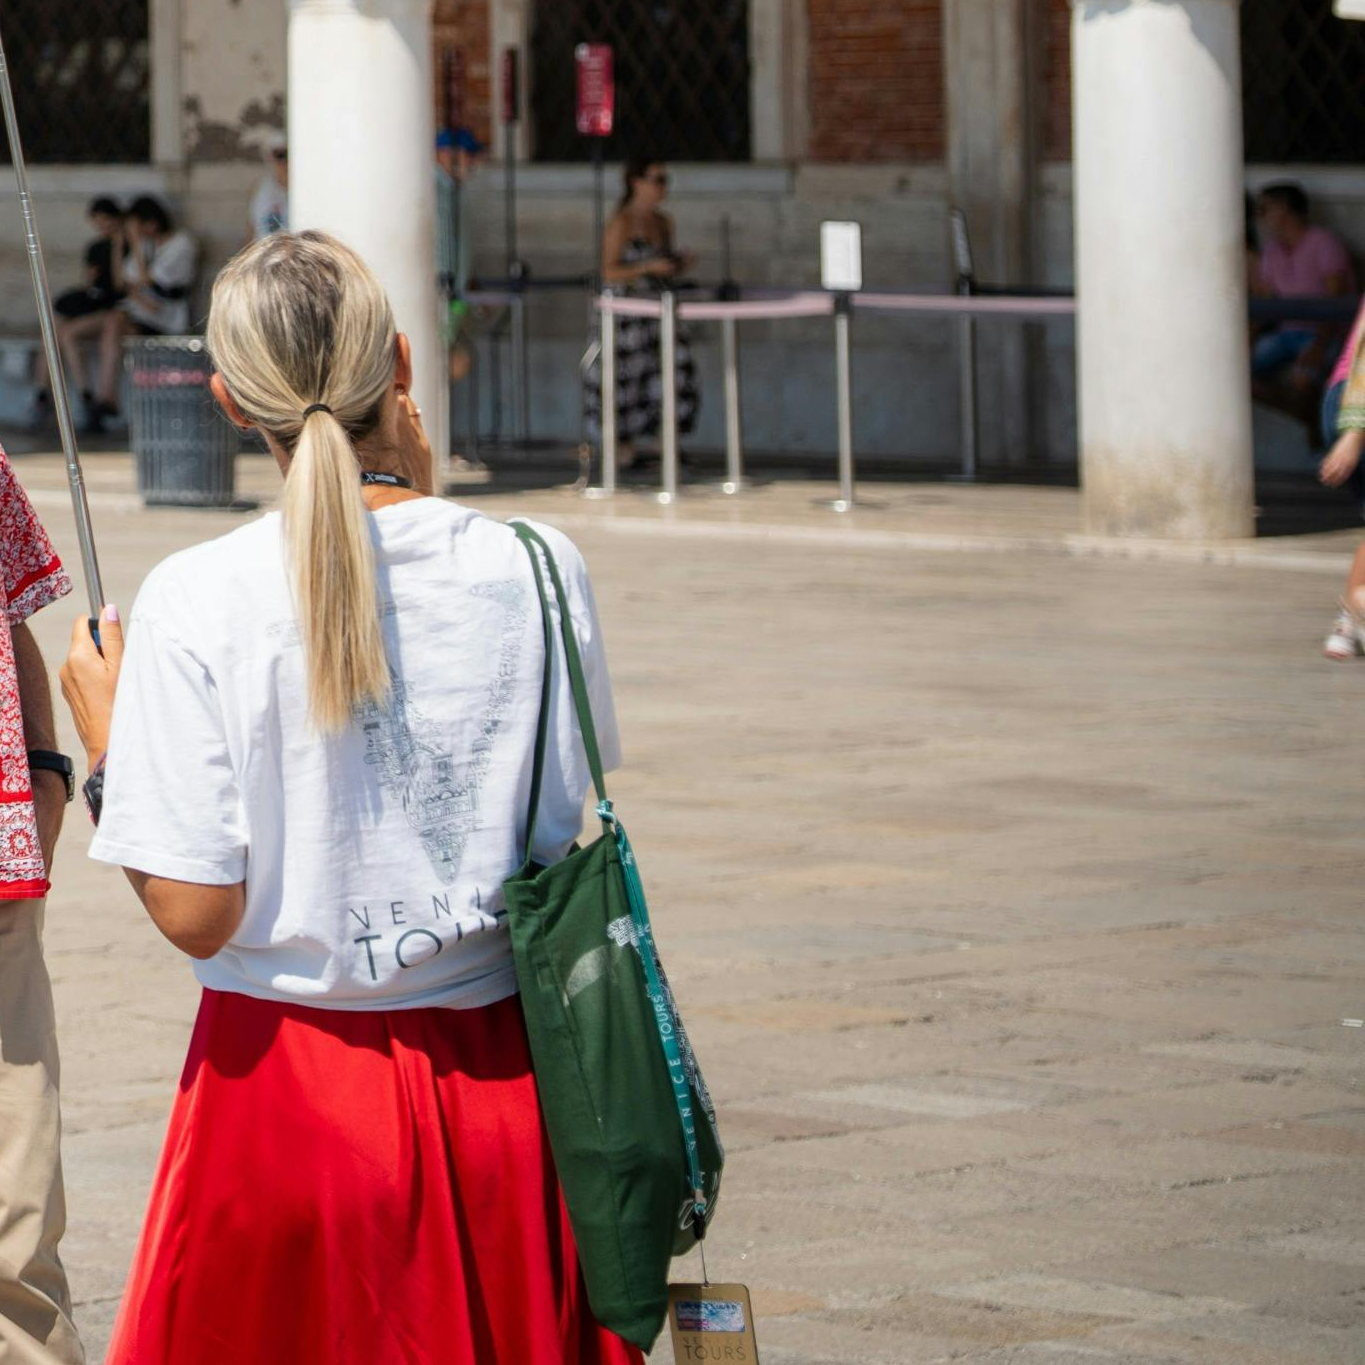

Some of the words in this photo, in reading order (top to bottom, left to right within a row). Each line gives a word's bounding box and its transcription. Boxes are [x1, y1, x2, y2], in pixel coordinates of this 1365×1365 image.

[350, 886, 481, 930] VENI
[653, 994, 675, 1043] TOURS
[683, 1345, 747, 1361] TOURS
